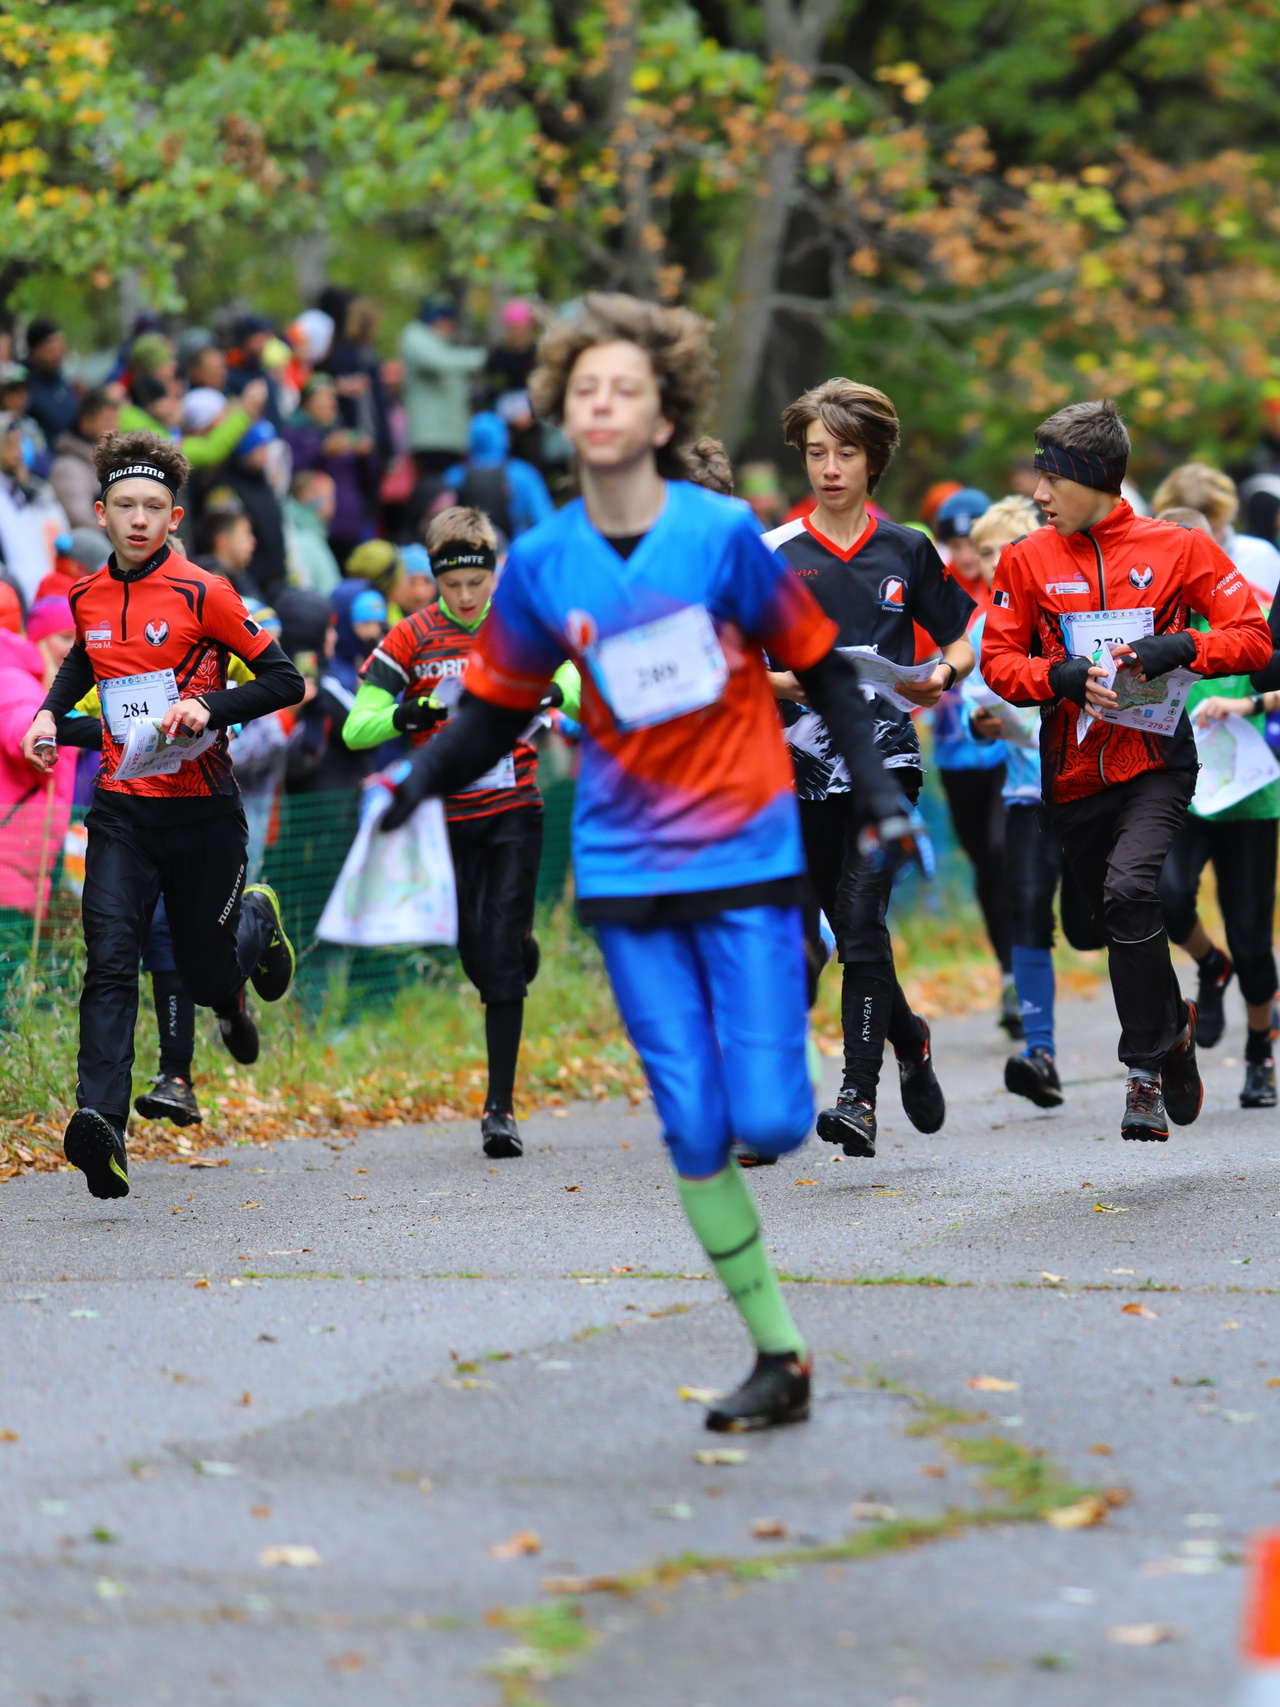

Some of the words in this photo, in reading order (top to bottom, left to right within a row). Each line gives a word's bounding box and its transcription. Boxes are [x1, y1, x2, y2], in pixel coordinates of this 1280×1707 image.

[108, 465, 165, 482] noname
[1223, 581, 1244, 597] team
[121, 701, 150, 720] 284
[1147, 721, 1171, 731] 279.2
[217, 863, 245, 926] noname
